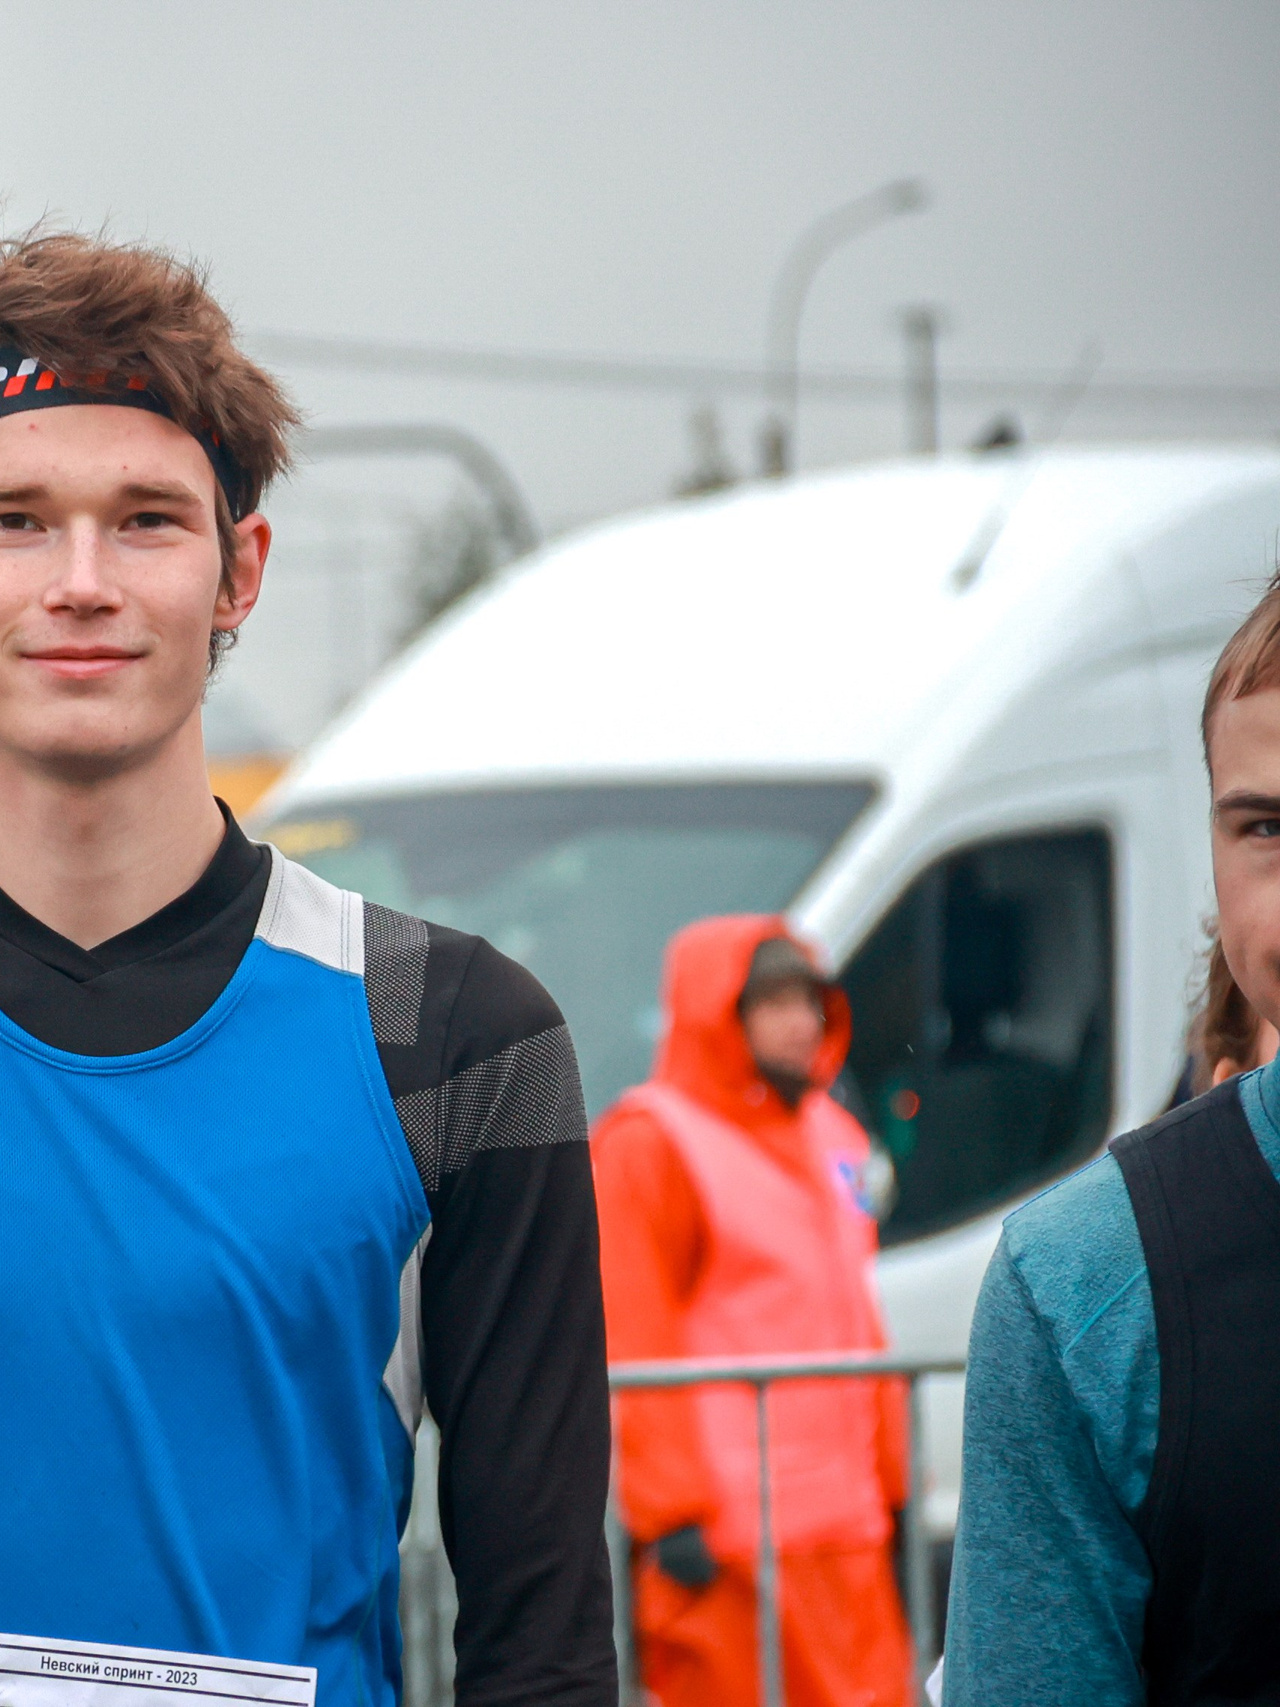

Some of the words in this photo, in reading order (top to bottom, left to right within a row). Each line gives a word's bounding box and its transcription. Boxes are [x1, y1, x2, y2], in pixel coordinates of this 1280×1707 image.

[40, 1656, 100, 1675] Невский
[104, 1665, 153, 1681] спринт
[166, 1670, 198, 1686] 2023
